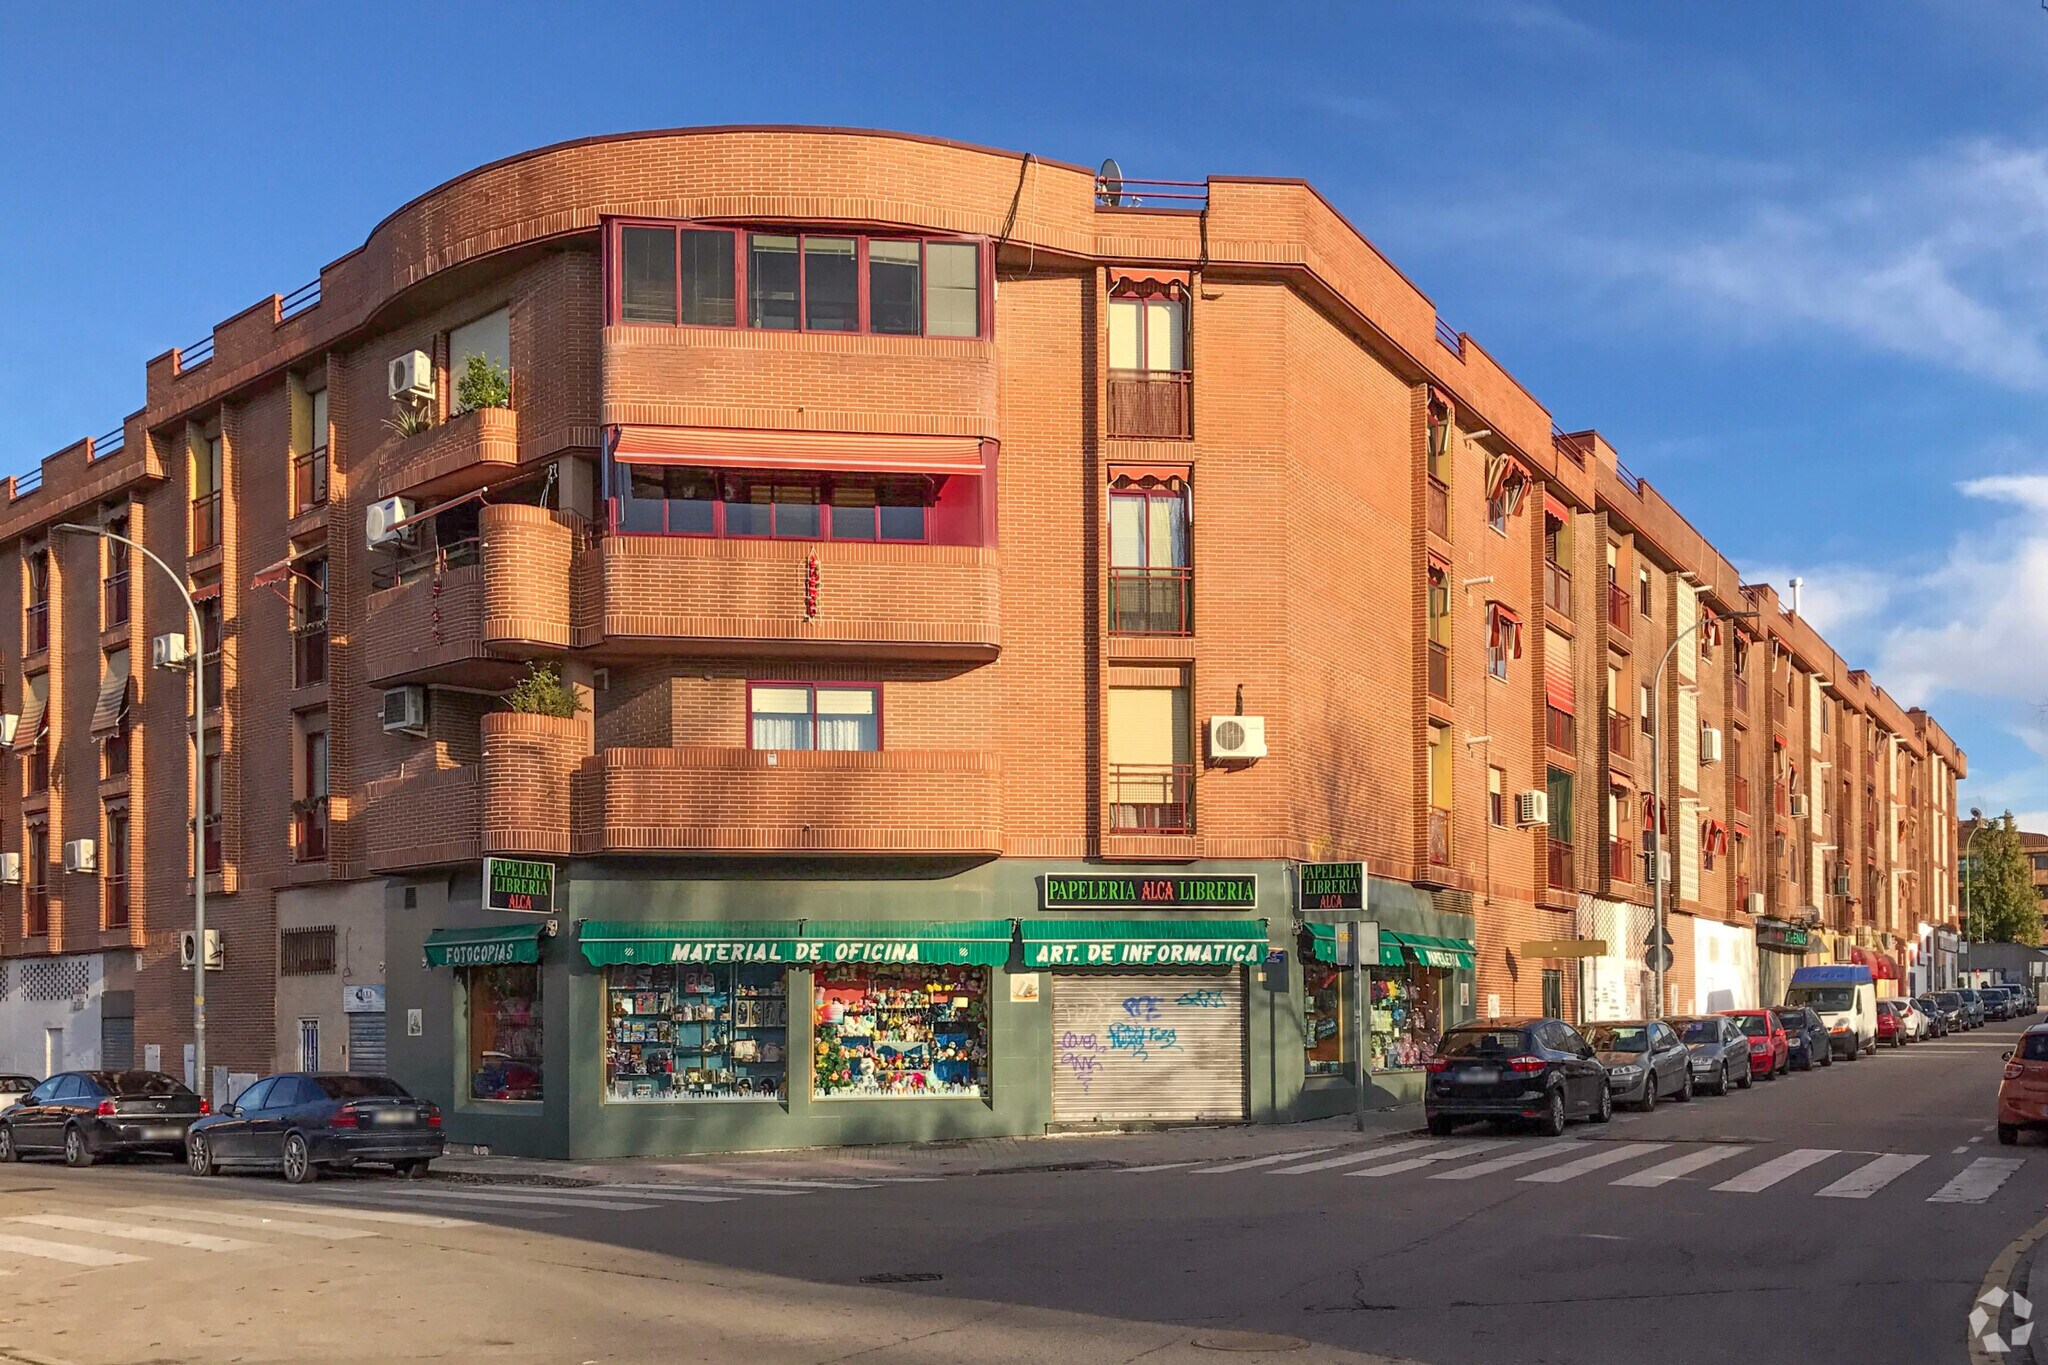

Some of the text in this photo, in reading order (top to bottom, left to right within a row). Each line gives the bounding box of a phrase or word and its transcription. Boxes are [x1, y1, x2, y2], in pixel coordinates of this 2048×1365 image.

[491, 860, 552, 880] PAPELERIA
[1302, 862, 1362, 880] PAPELERIA
[494, 876, 548, 896] LIBRERIA
[1049, 880, 1254, 900] PAPELERIA ALCA LIBRERIA
[1305, 879, 1359, 895] LIBRERIA
[508, 893, 532, 910] ALCA
[1319, 894, 1343, 909] ALCA
[446, 943, 514, 964] FOTOCOPIAS
[671, 943, 919, 961] MATERIAL DE OFICINA
[1036, 944, 1080, 962] ART.
[1087, 944, 1115, 962] DE
[1121, 943, 1258, 962] INFORMATICA
[1426, 950, 1461, 967] PAPELERIA
